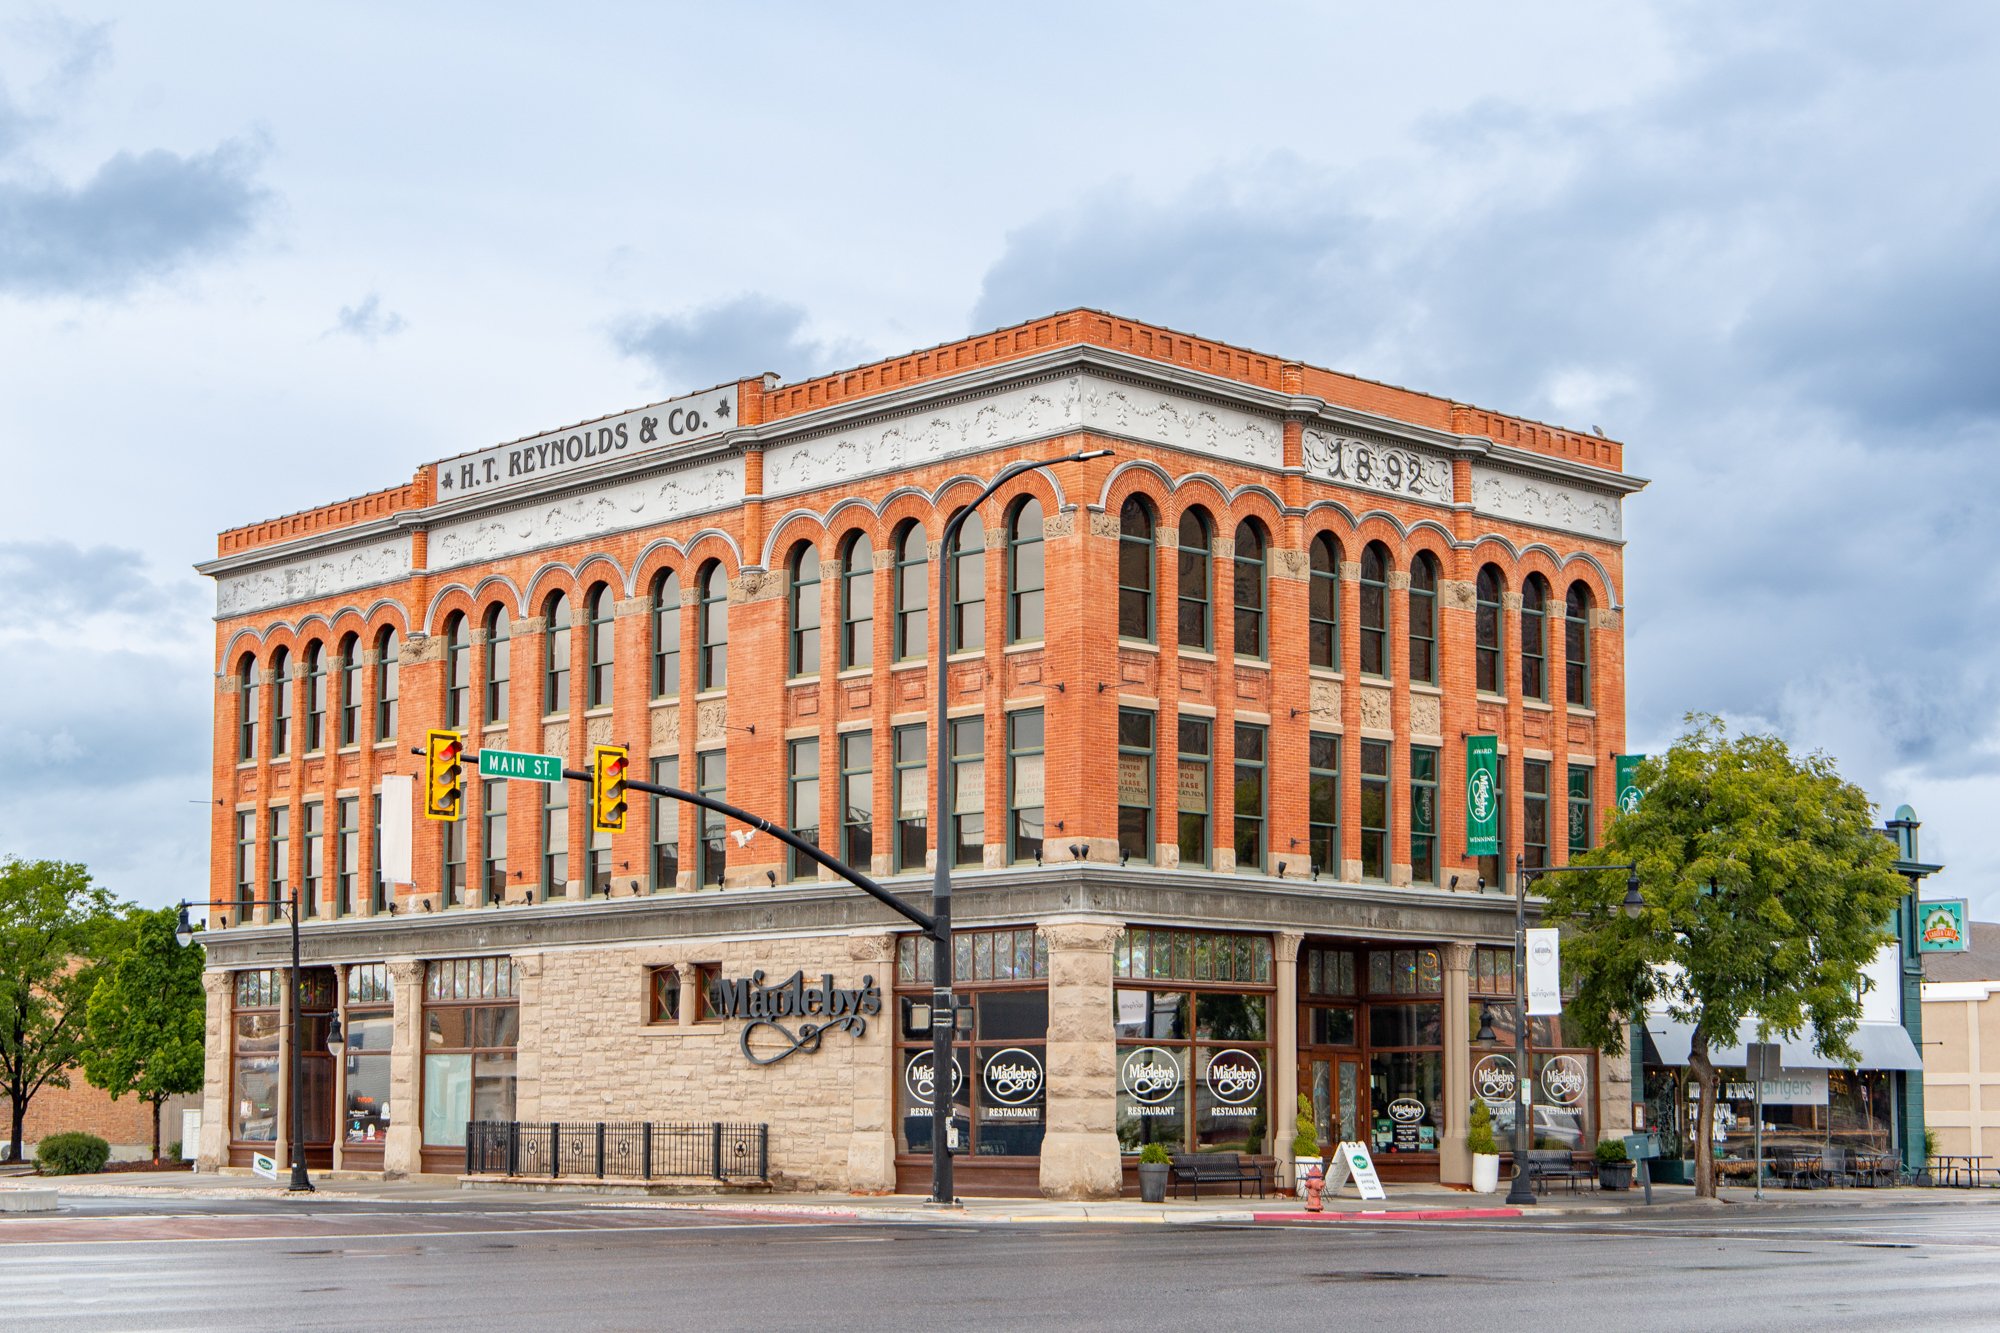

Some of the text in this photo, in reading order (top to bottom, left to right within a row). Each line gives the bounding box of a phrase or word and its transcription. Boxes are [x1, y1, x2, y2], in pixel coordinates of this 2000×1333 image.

[460, 407, 708, 489] H.T. REYNOLDS & Co.
[1328, 440, 1423, 495] 1892
[489, 755, 552, 777] MAIN ST.
[1180, 781, 1199, 789] EASE
[991, 1063, 1037, 1089] Magleby's
[1129, 1062, 1174, 1088] Magleby's
[1213, 1063, 1256, 1089] Magleby's
[1479, 1067, 1515, 1091] Magleby's
[1547, 1069, 1582, 1092] Magleby's
[989, 1108, 1037, 1116] RESTAURANT
[1128, 1106, 1175, 1116] RESTAURANT
[1211, 1107, 1257, 1116] RESTAURANT
[1489, 1107, 1515, 1115] TAURANT
[1546, 1107, 1582, 1115] RESTAURANT
